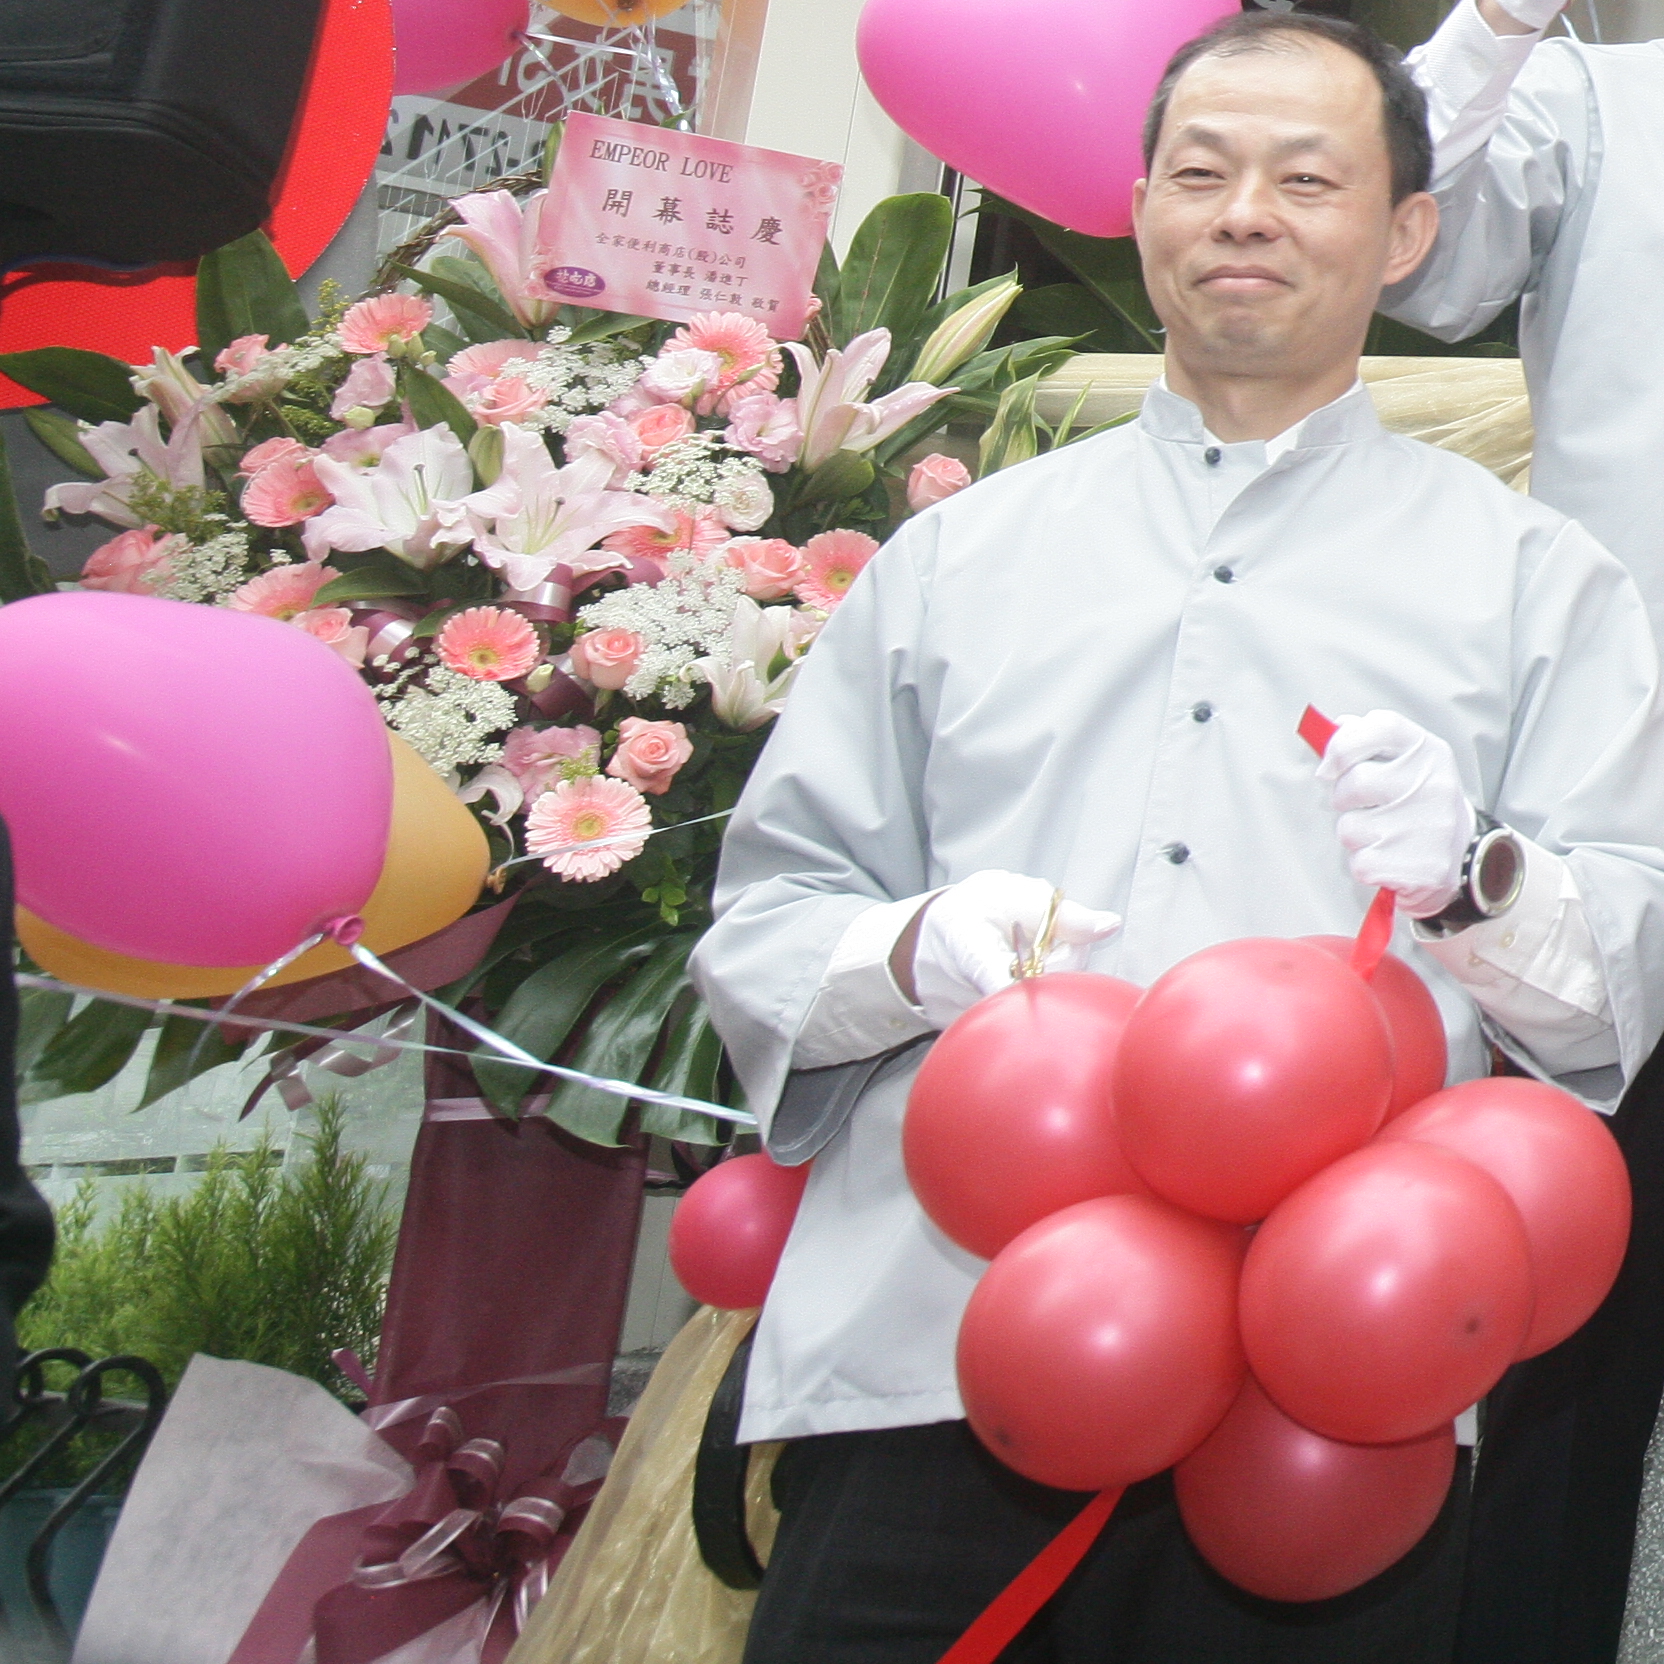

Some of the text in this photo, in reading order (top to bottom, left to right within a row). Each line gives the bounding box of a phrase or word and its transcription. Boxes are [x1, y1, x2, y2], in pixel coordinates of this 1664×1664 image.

[589, 140, 734, 184] EMPEOR LOVE
[602, 188, 784, 246] 開幕誌慶
